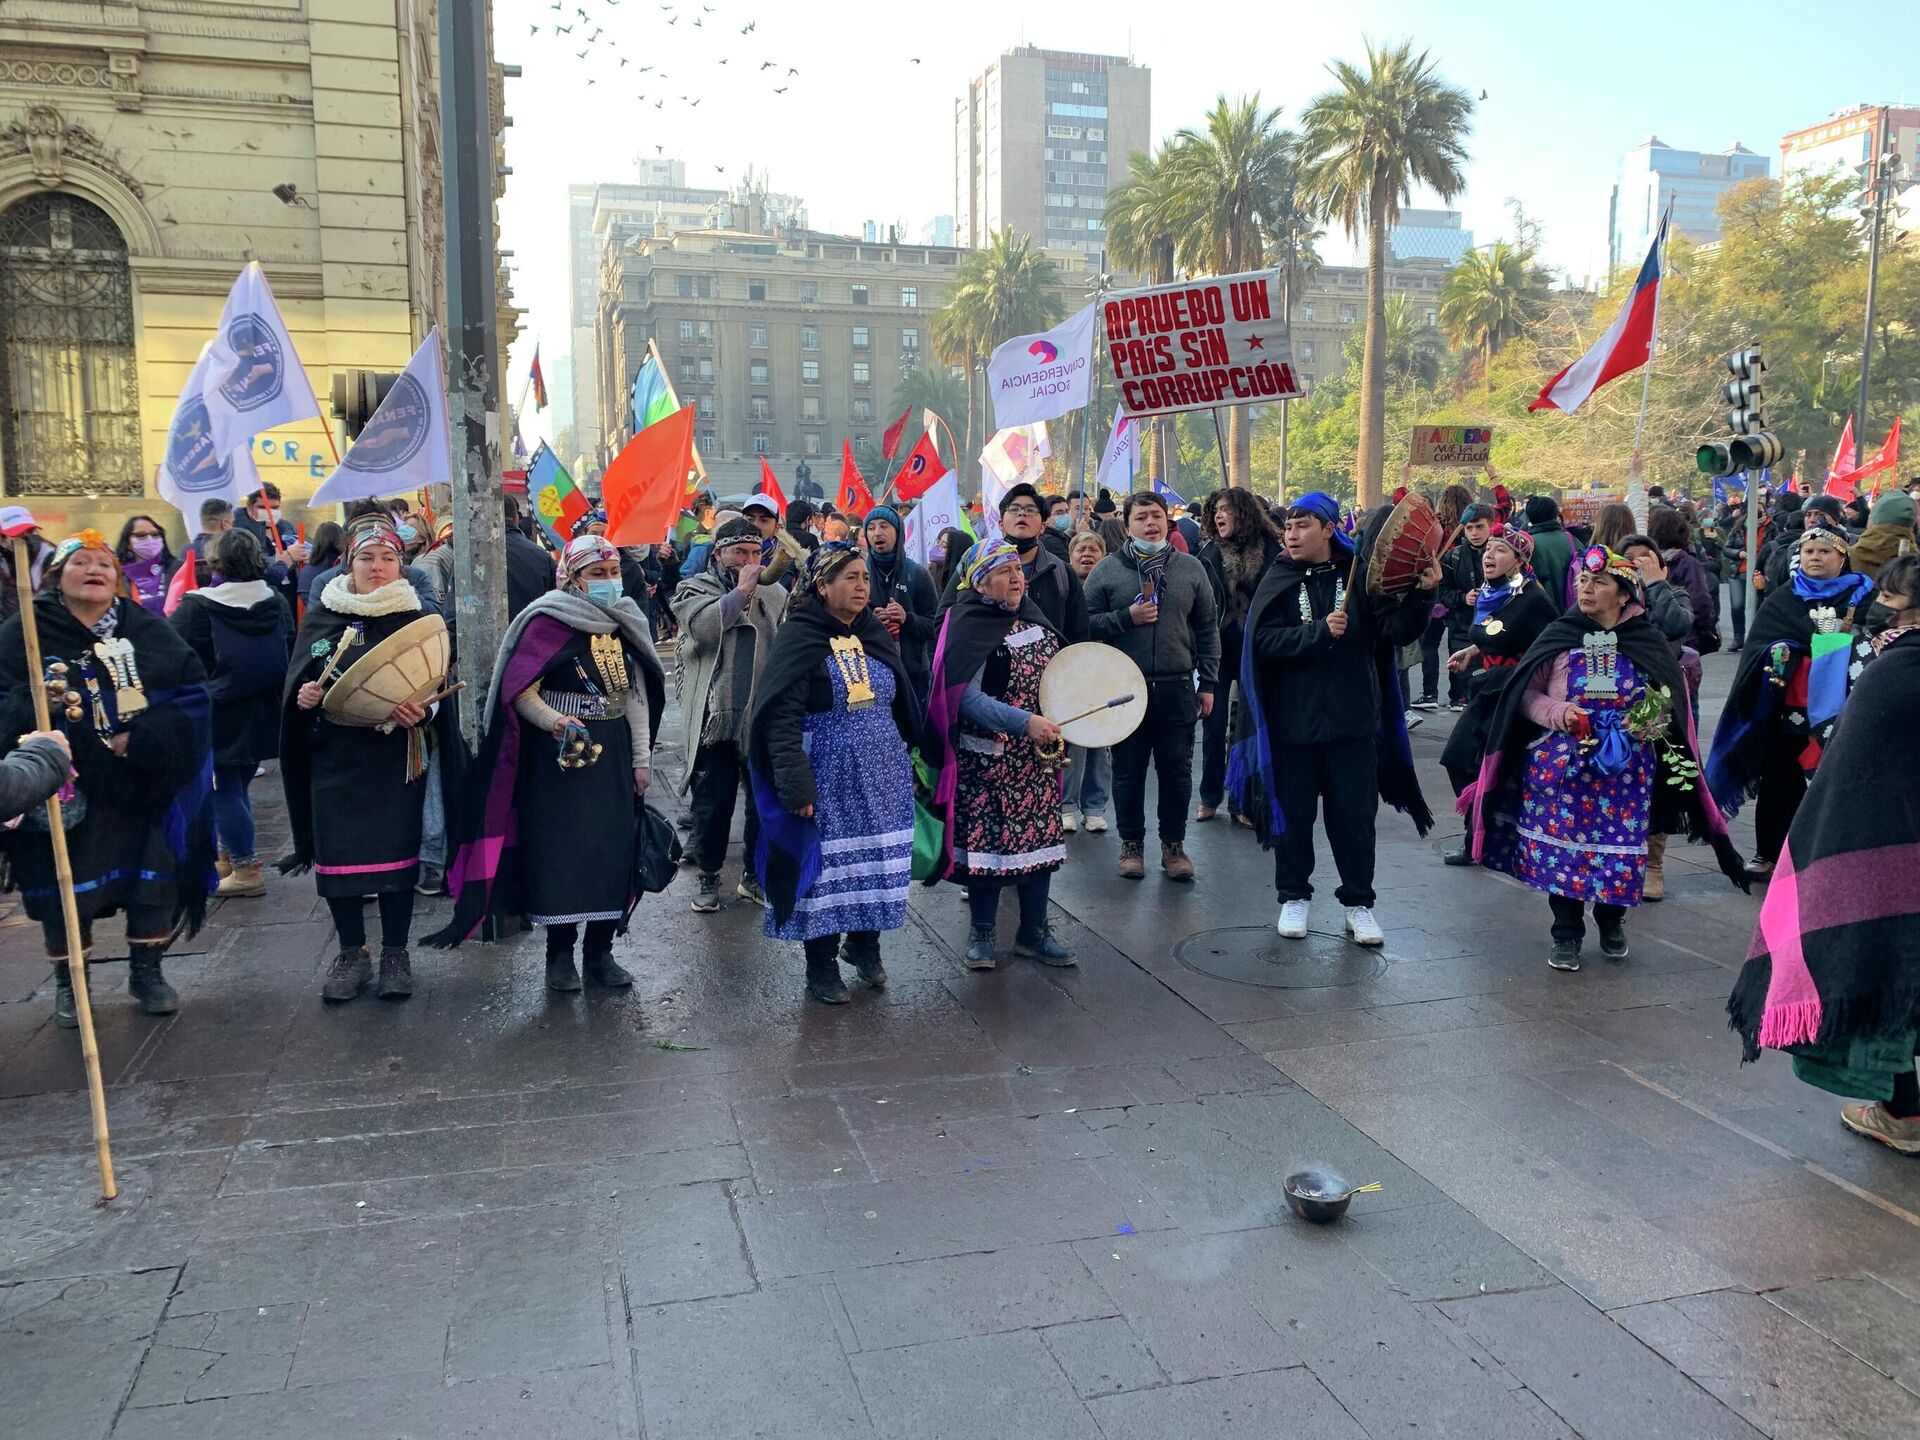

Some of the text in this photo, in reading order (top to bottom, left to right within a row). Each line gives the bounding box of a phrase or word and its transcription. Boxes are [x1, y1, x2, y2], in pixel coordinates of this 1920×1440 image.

[1104, 279, 1271, 341] APRUEBO UN
[1431, 428, 1490, 443] APRUEBO
[1434, 444, 1473, 454] NUEVA
